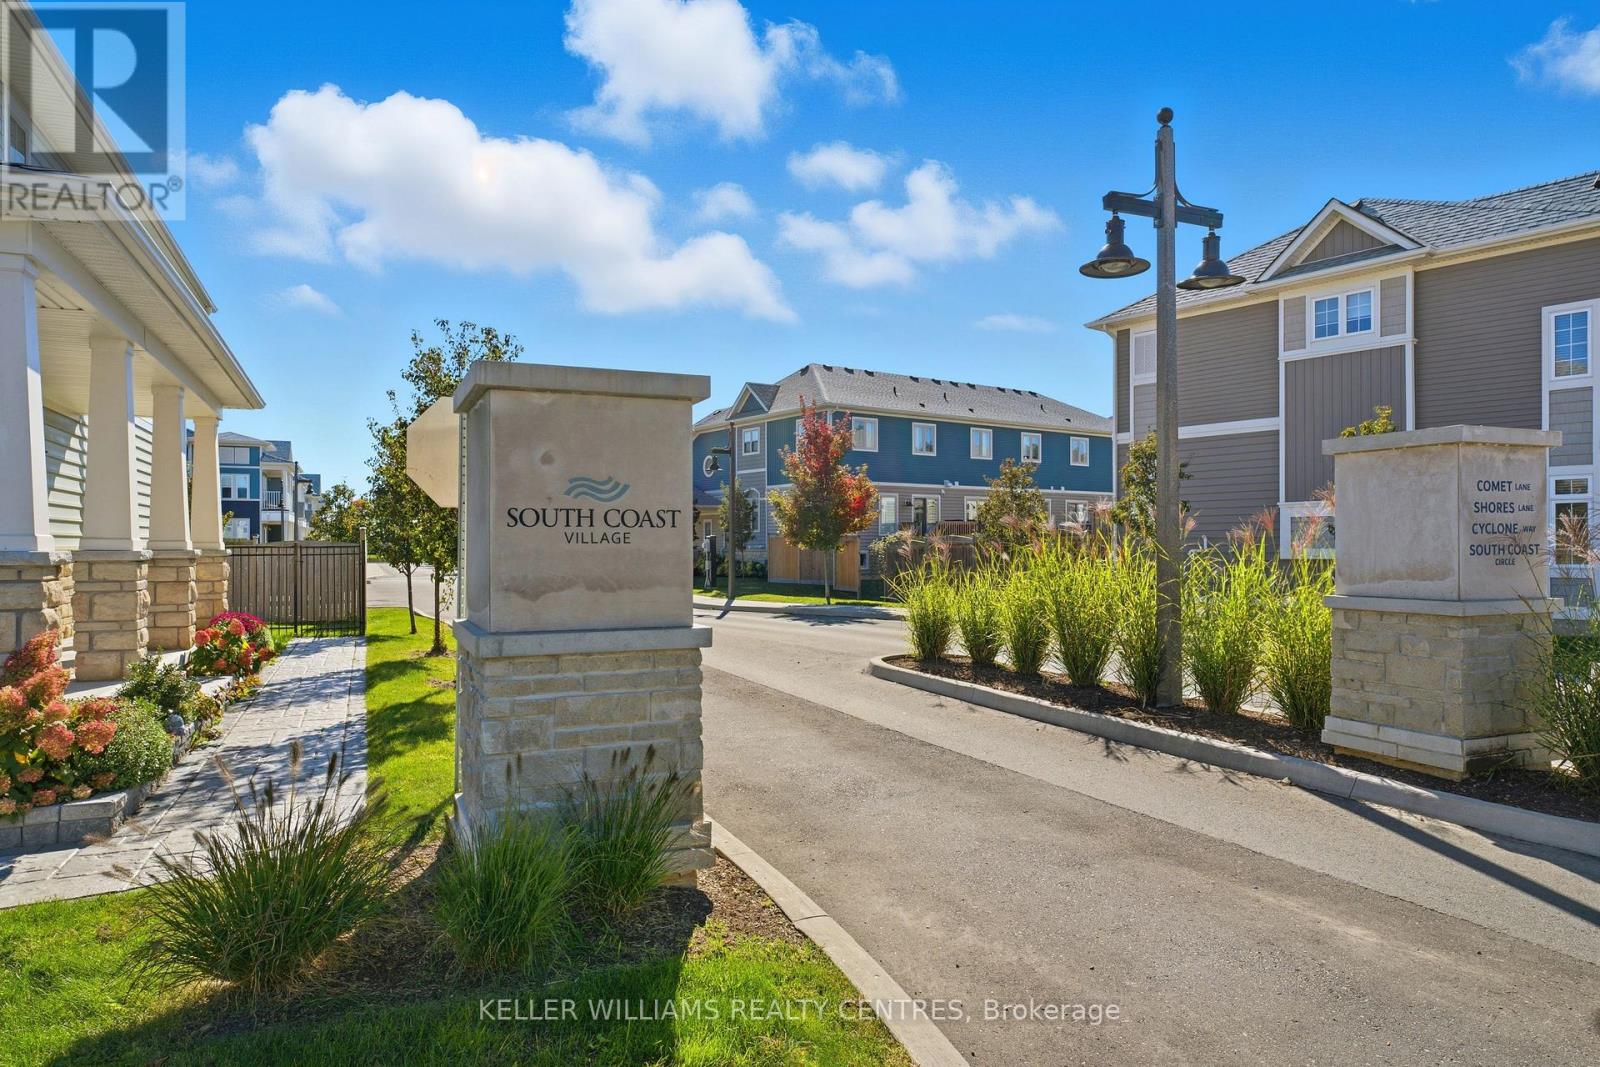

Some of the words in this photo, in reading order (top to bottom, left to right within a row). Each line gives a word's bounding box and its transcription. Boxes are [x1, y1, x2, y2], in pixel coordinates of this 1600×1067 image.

[1477, 480, 1512, 492] COMET
[1473, 501, 1515, 513] SHORES
[507, 507, 595, 528] SOUTH
[603, 508, 682, 528] COAST
[1472, 523, 1518, 535] CYCLONE
[564, 532, 631, 544] VILLAGE
[1469, 544, 1505, 556] SOUTH
[1507, 544, 1540, 556] COAST
[1495, 558, 1516, 566] CIRCLE
